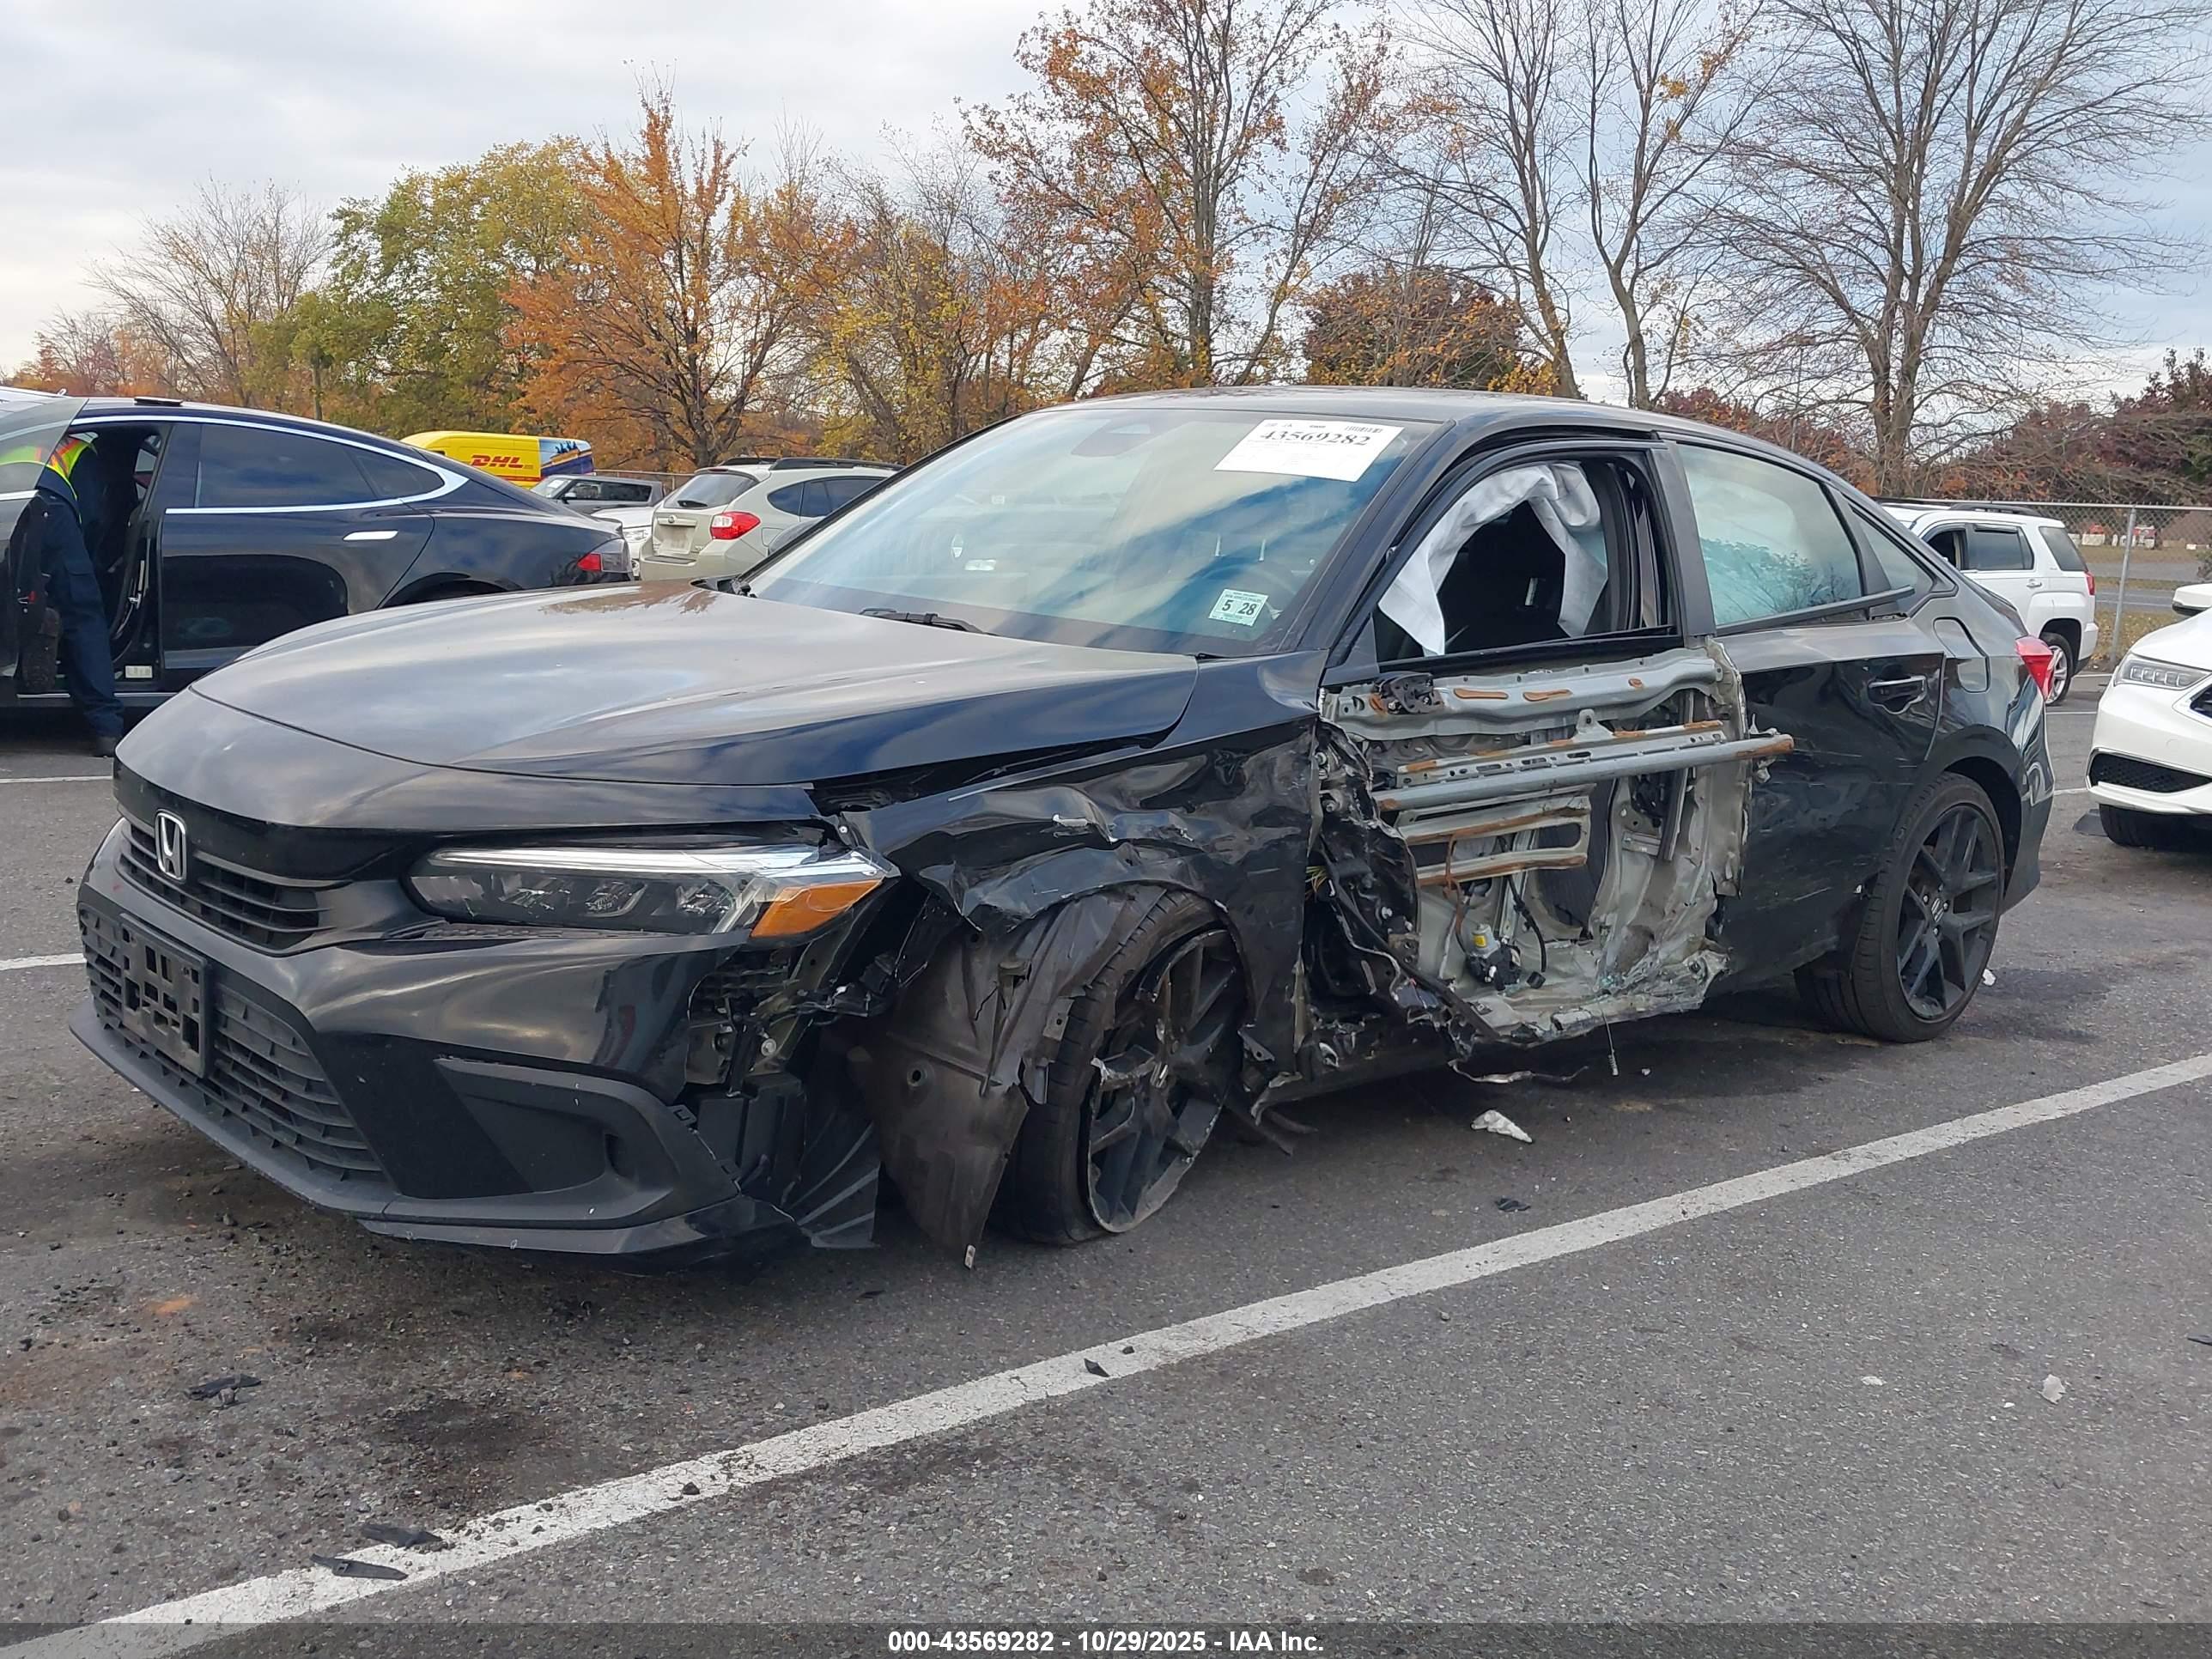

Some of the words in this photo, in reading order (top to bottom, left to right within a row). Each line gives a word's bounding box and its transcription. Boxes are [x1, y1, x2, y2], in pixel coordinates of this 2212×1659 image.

[1261, 430, 1370, 446] 43569282
[471, 454, 524, 469] DHL
[1222, 599, 1234, 611] 5
[1237, 602, 1257, 616] 28
